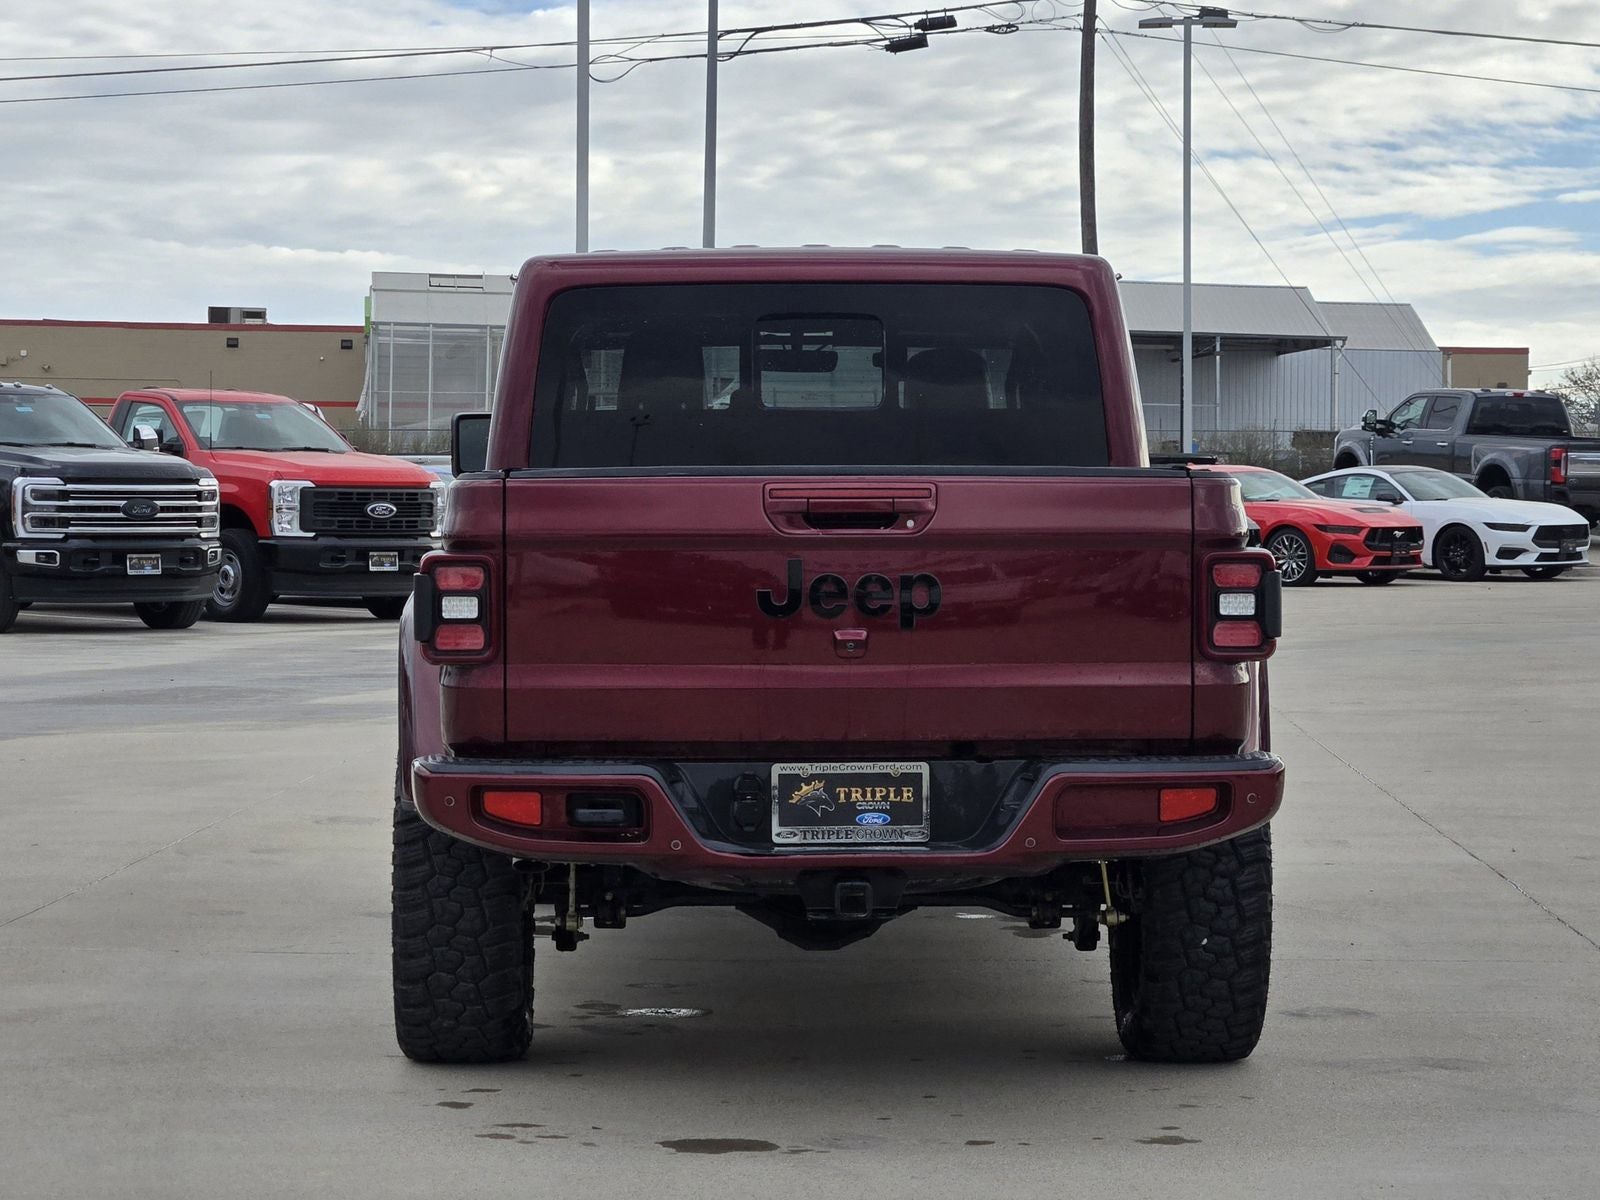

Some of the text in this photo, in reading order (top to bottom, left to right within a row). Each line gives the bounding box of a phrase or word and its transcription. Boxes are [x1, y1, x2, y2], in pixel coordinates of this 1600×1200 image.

[756, 558, 942, 629] Jeep
[779, 763, 923, 772] www.TripleCrownFord.com
[835, 787, 914, 802] TRIPLE
[856, 802, 890, 810] CROWN
[800, 829, 853, 840] TRIPLE
[856, 828, 904, 840] CROWN
